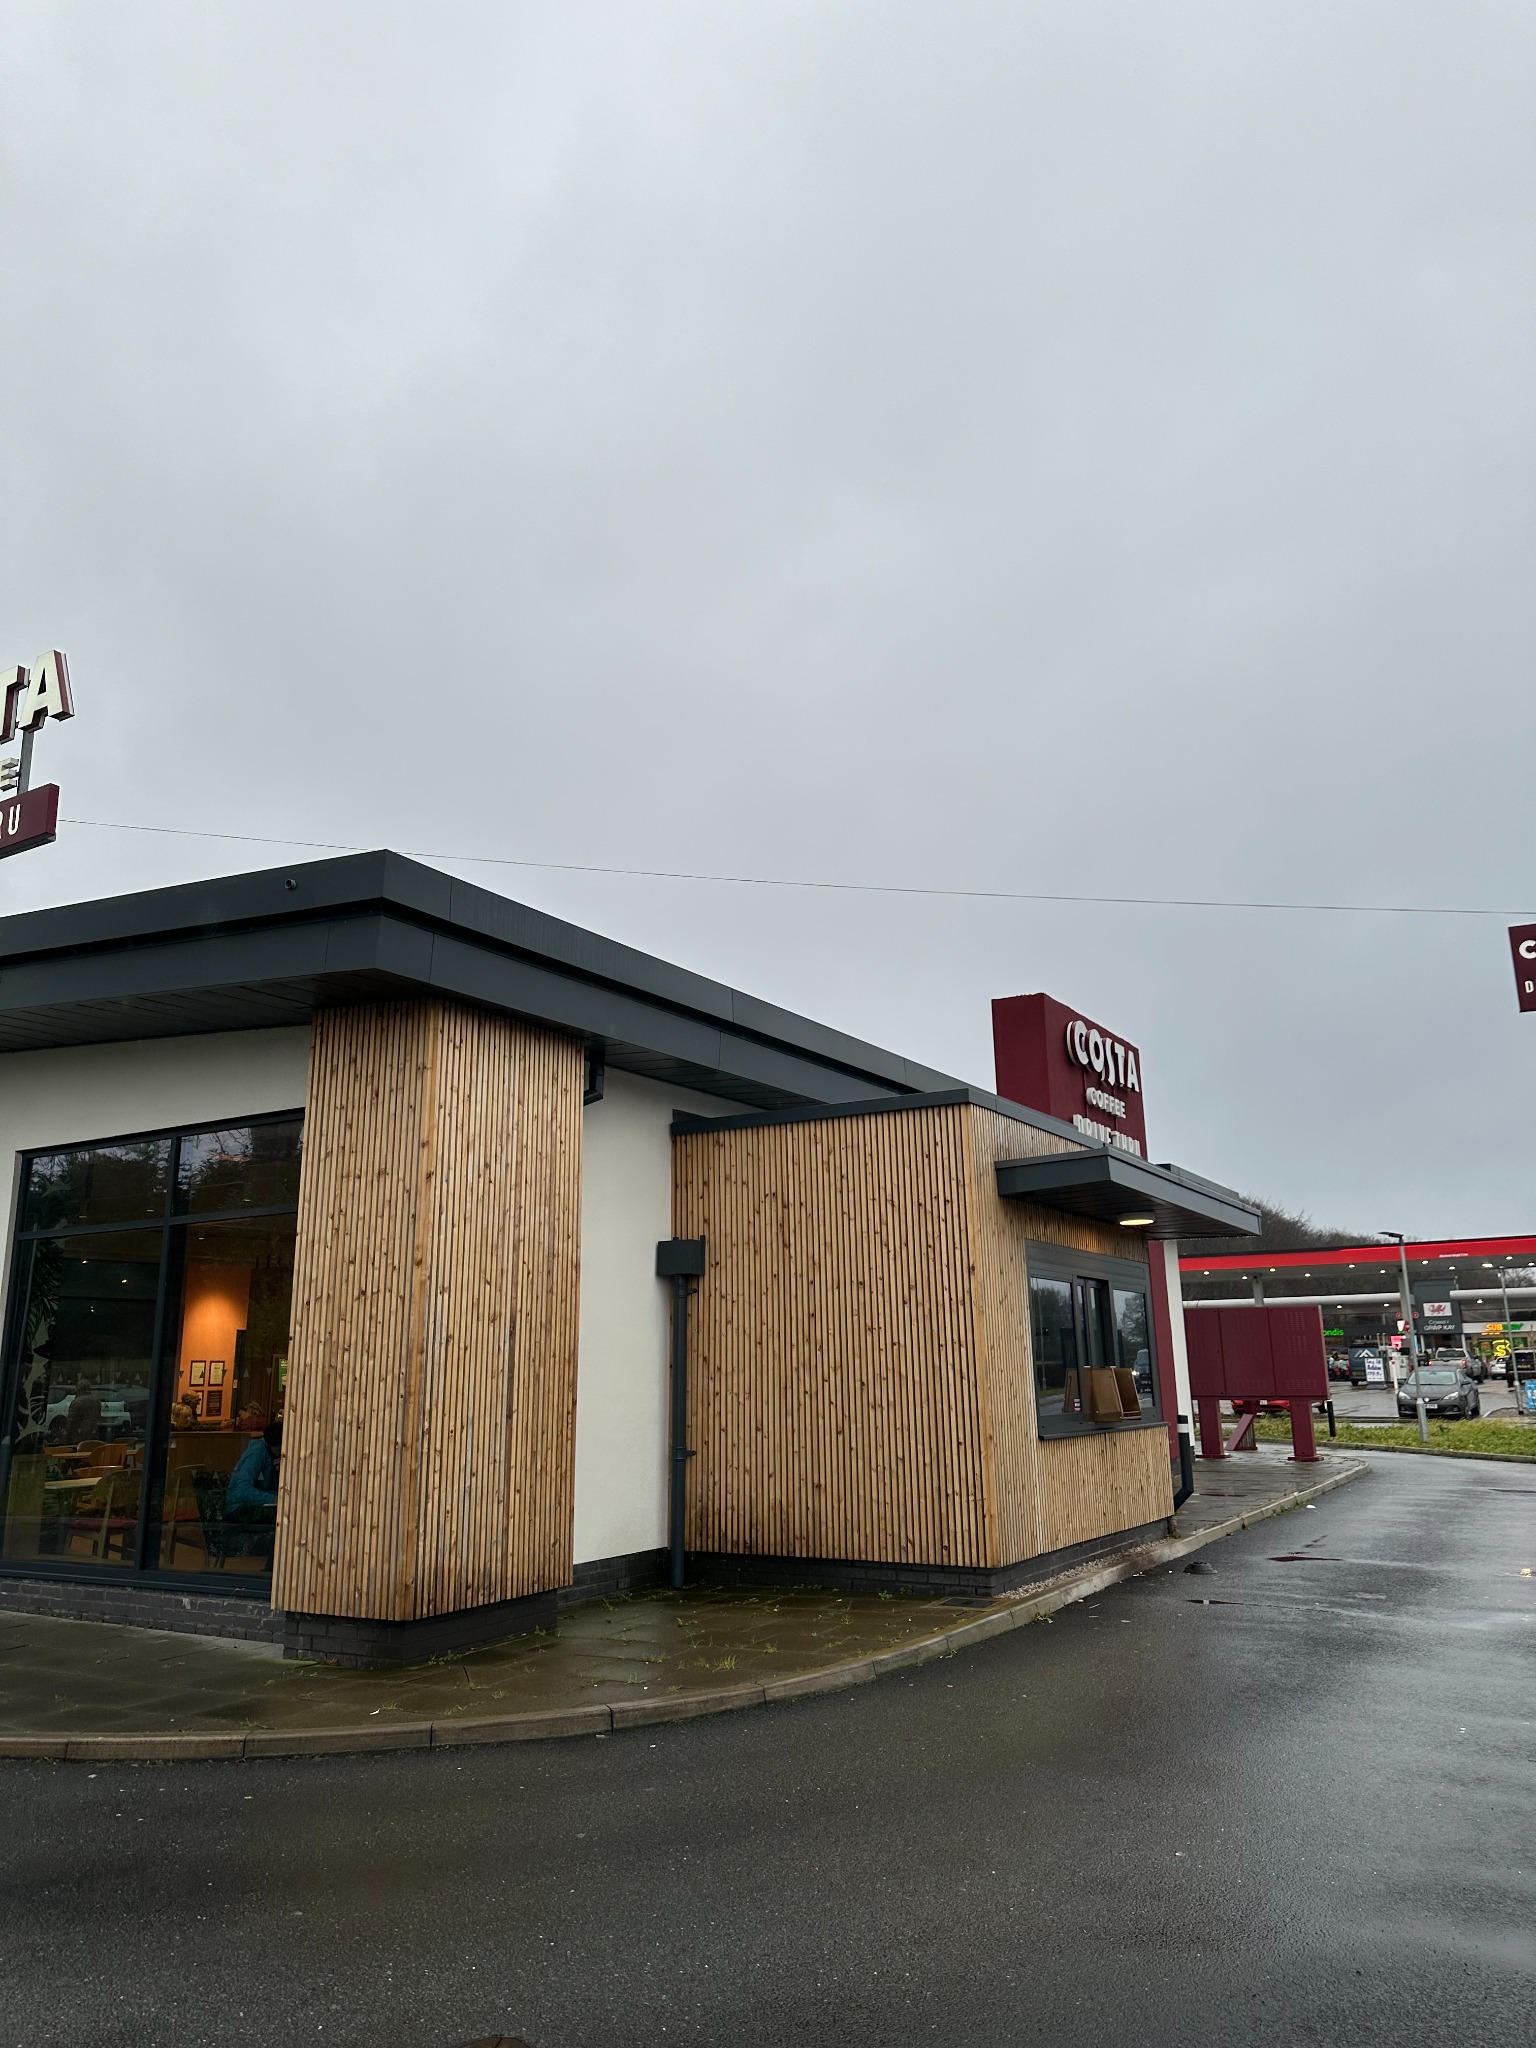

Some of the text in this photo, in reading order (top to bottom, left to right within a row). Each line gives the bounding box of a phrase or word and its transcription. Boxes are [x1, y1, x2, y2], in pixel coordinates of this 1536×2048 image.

[0, 803, 21, 839] U
[1066, 1020, 1140, 1092] COSTA
[1086, 1087, 1126, 1119] COFFEE
[1323, 1327, 1344, 1337] ondis
